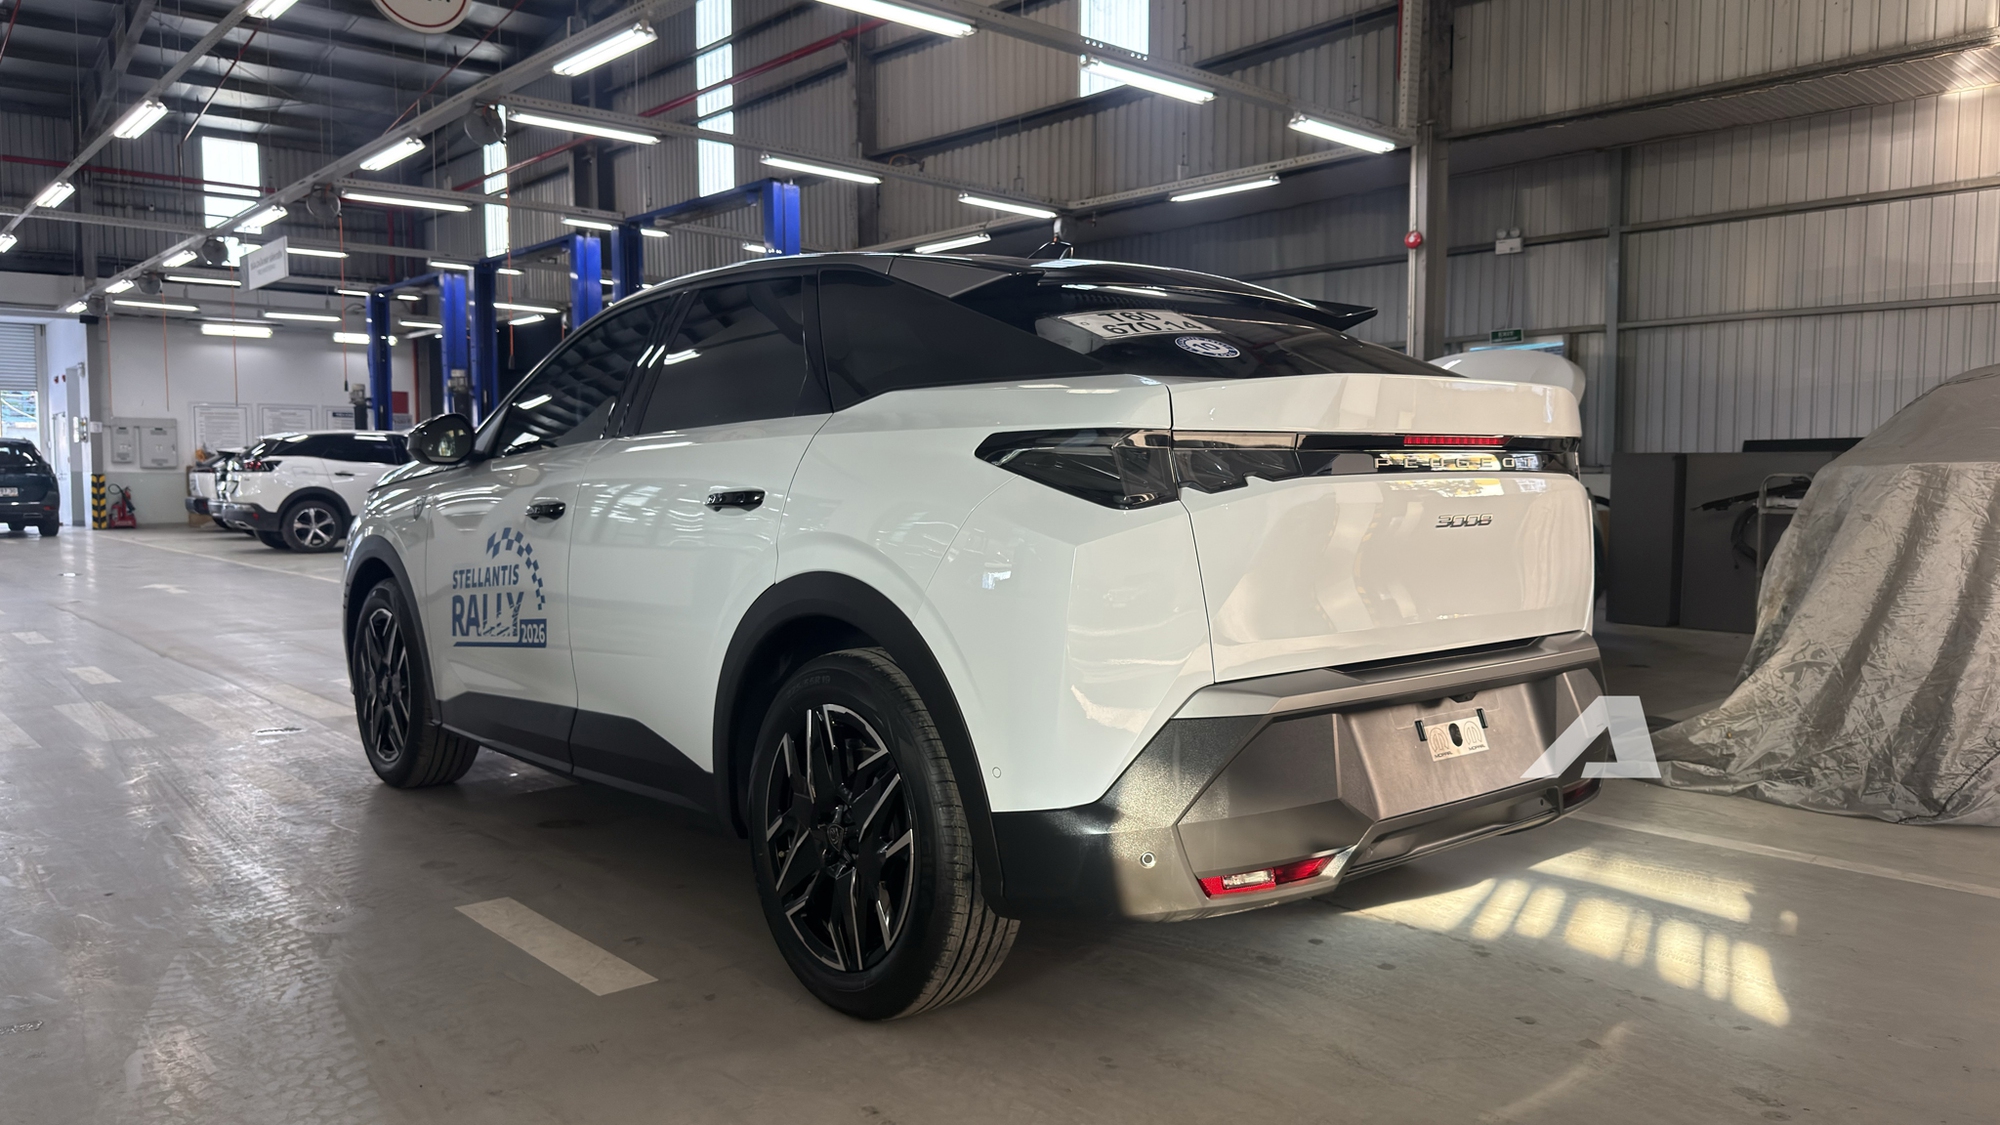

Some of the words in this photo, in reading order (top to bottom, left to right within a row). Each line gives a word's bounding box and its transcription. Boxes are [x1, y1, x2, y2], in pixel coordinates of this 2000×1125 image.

[1097, 311, 1161, 323] T60
[1102, 320, 1203, 334] 670.14
[1192, 342, 1220, 351] 10
[1374, 457, 1534, 469] PEUGEOT
[1435, 513, 1494, 528] 3008
[452, 563, 520, 590] STELLANTIS
[452, 591, 525, 637] RALLY
[521, 623, 546, 643] 2026
